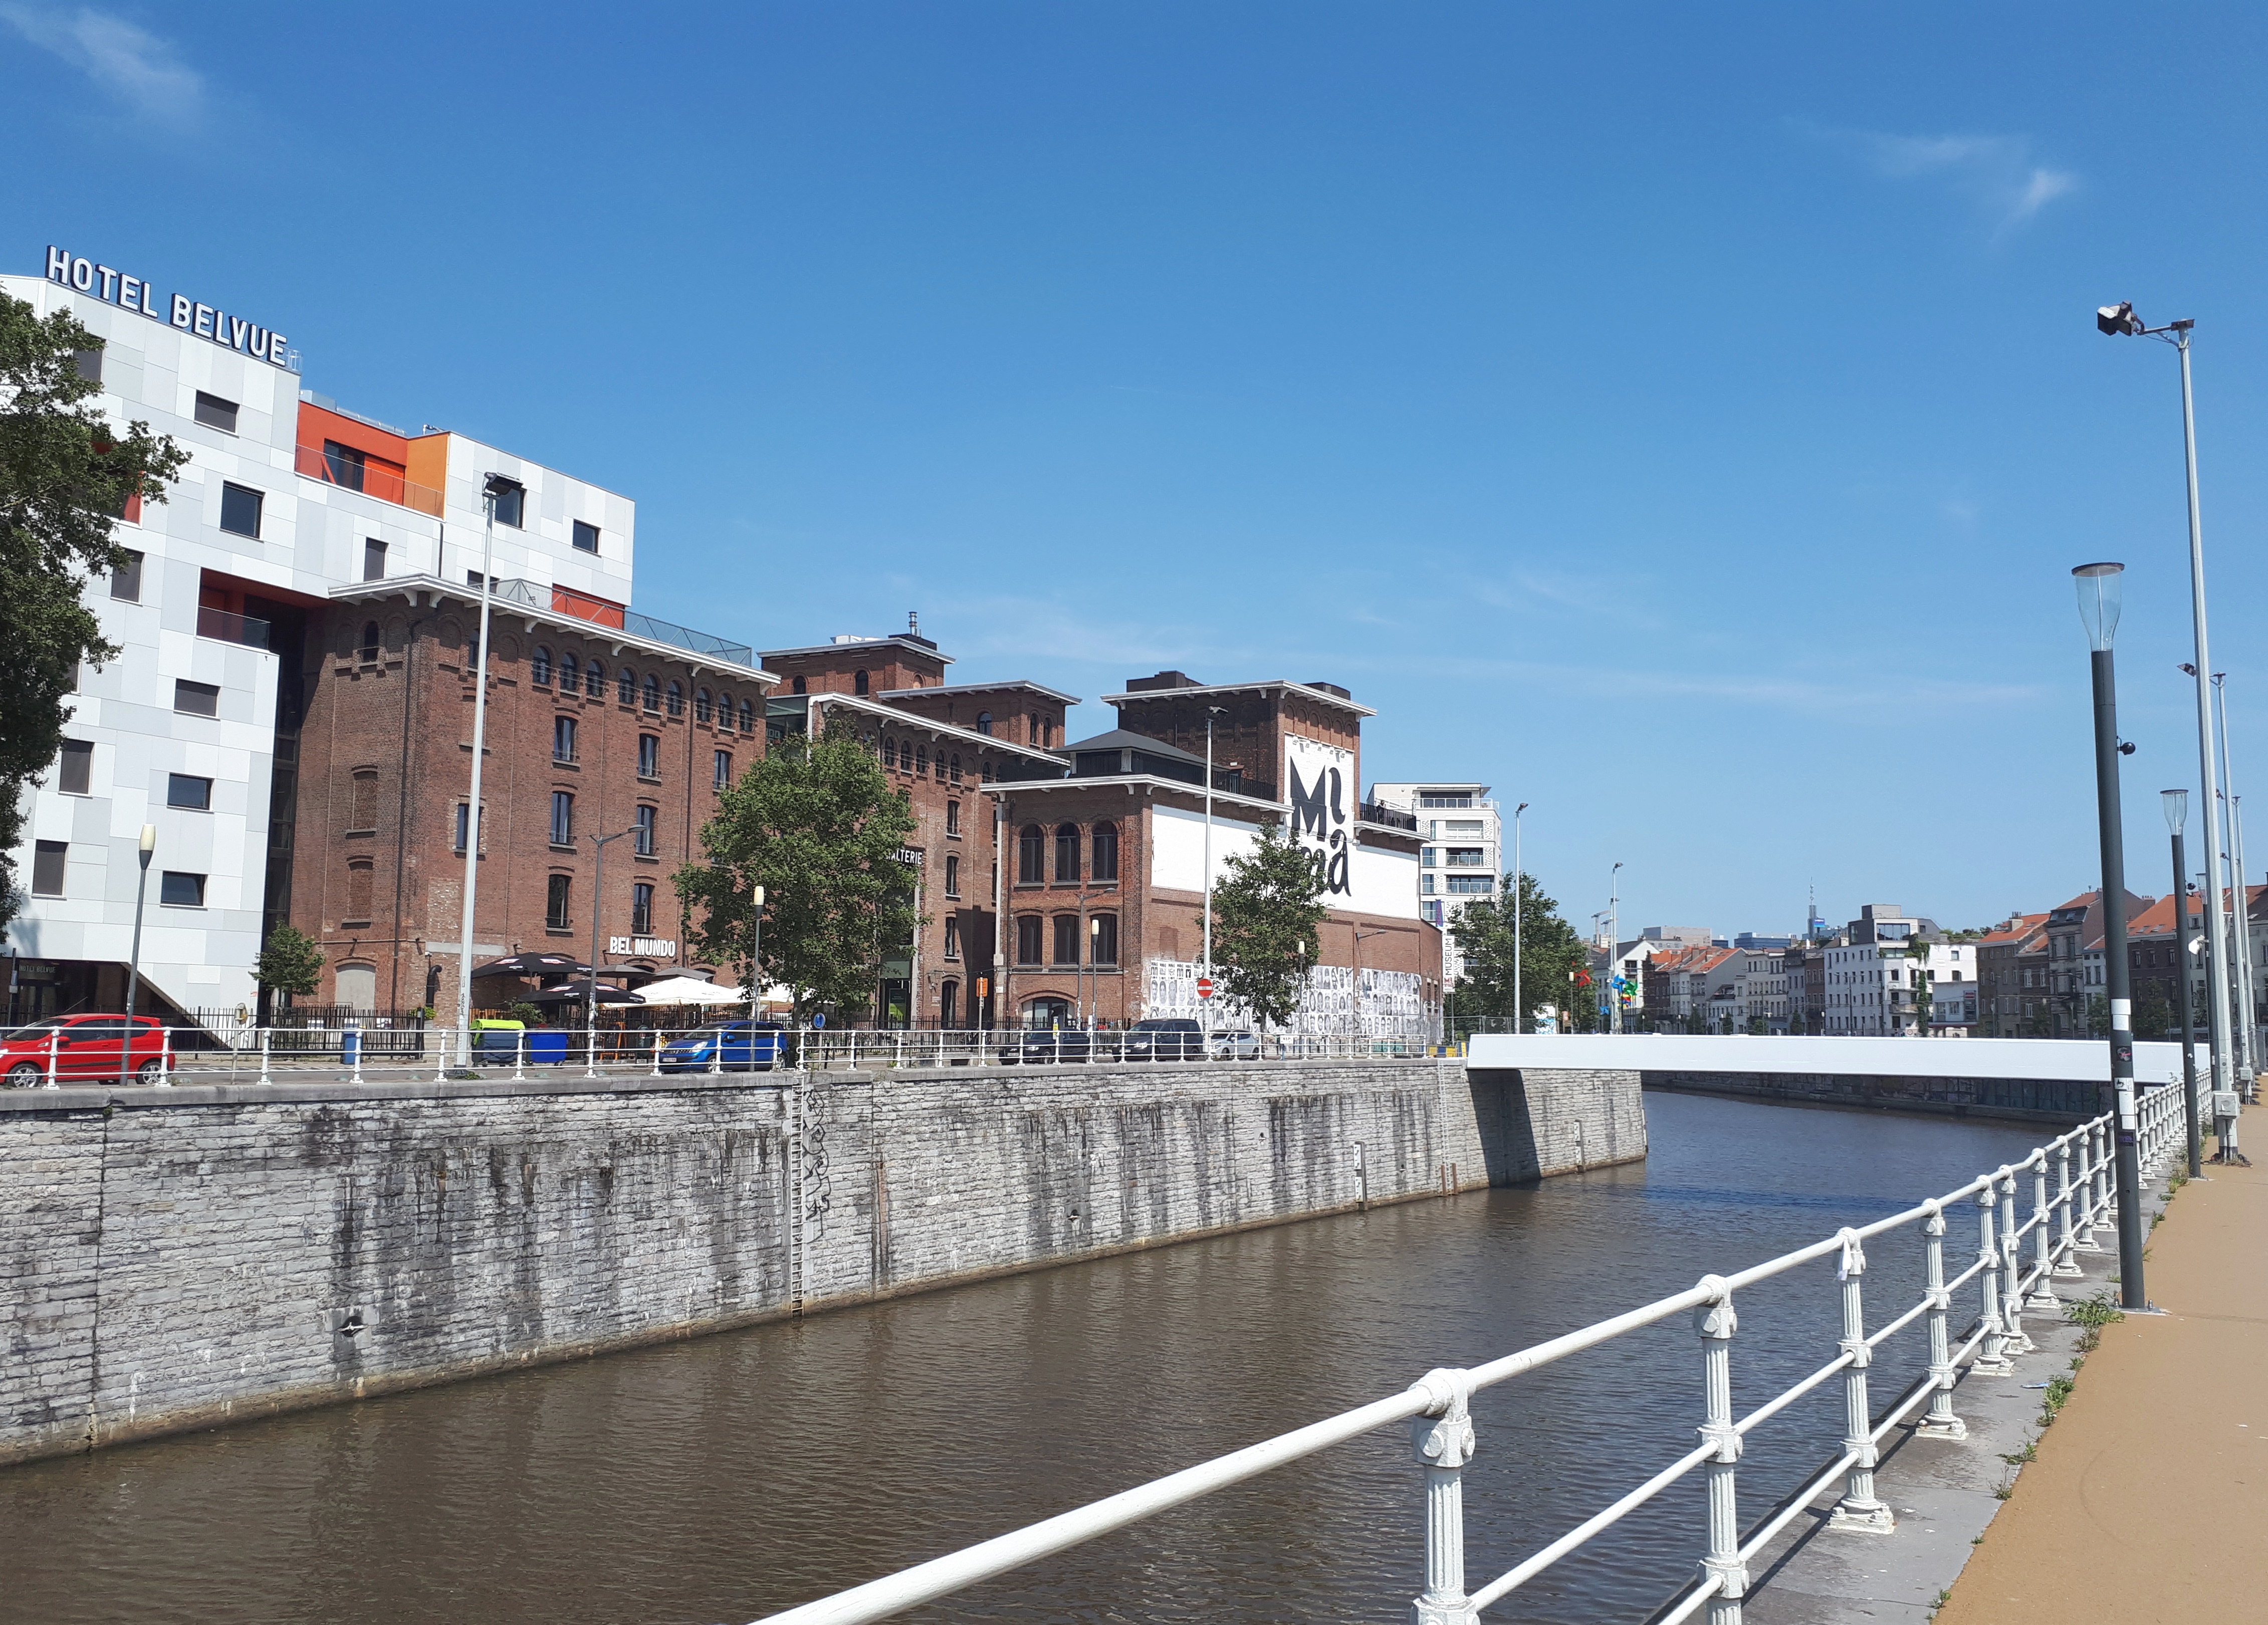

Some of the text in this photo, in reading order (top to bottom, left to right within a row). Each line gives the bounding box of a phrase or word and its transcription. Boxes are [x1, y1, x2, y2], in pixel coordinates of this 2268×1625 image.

[45, 245, 287, 367] HOTEL BELVUE
[610, 936, 675, 957] BEL MUNDO
